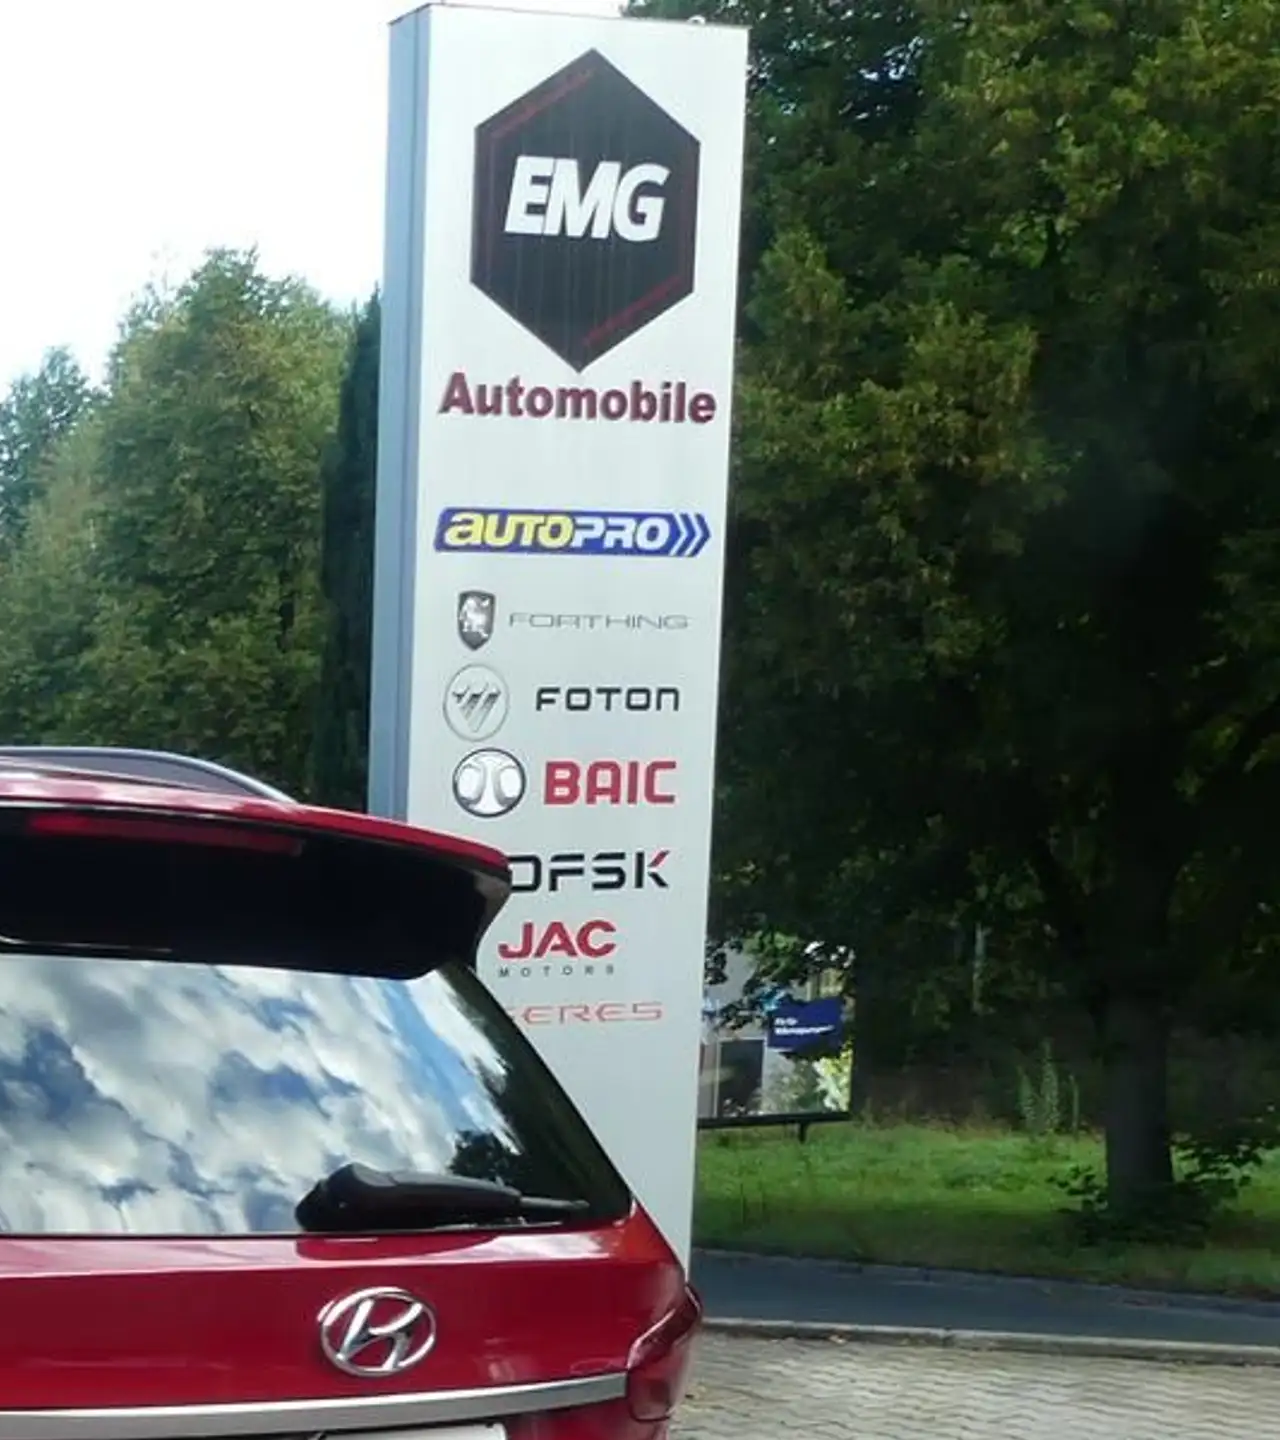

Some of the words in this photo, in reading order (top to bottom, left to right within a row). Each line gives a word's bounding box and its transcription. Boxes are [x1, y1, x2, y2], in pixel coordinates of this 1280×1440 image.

[504, 155, 672, 243] EMG
[437, 372, 718, 424] Automobile
[508, 611, 690, 630] FORTHING
[535, 686, 681, 712] FOTON
[543, 760, 678, 806] BAIC
[507, 849, 671, 892] DFSK
[497, 919, 617, 959] JAC
[497, 964, 615, 978] MOTORS
[510, 1001, 663, 1026] ERES
